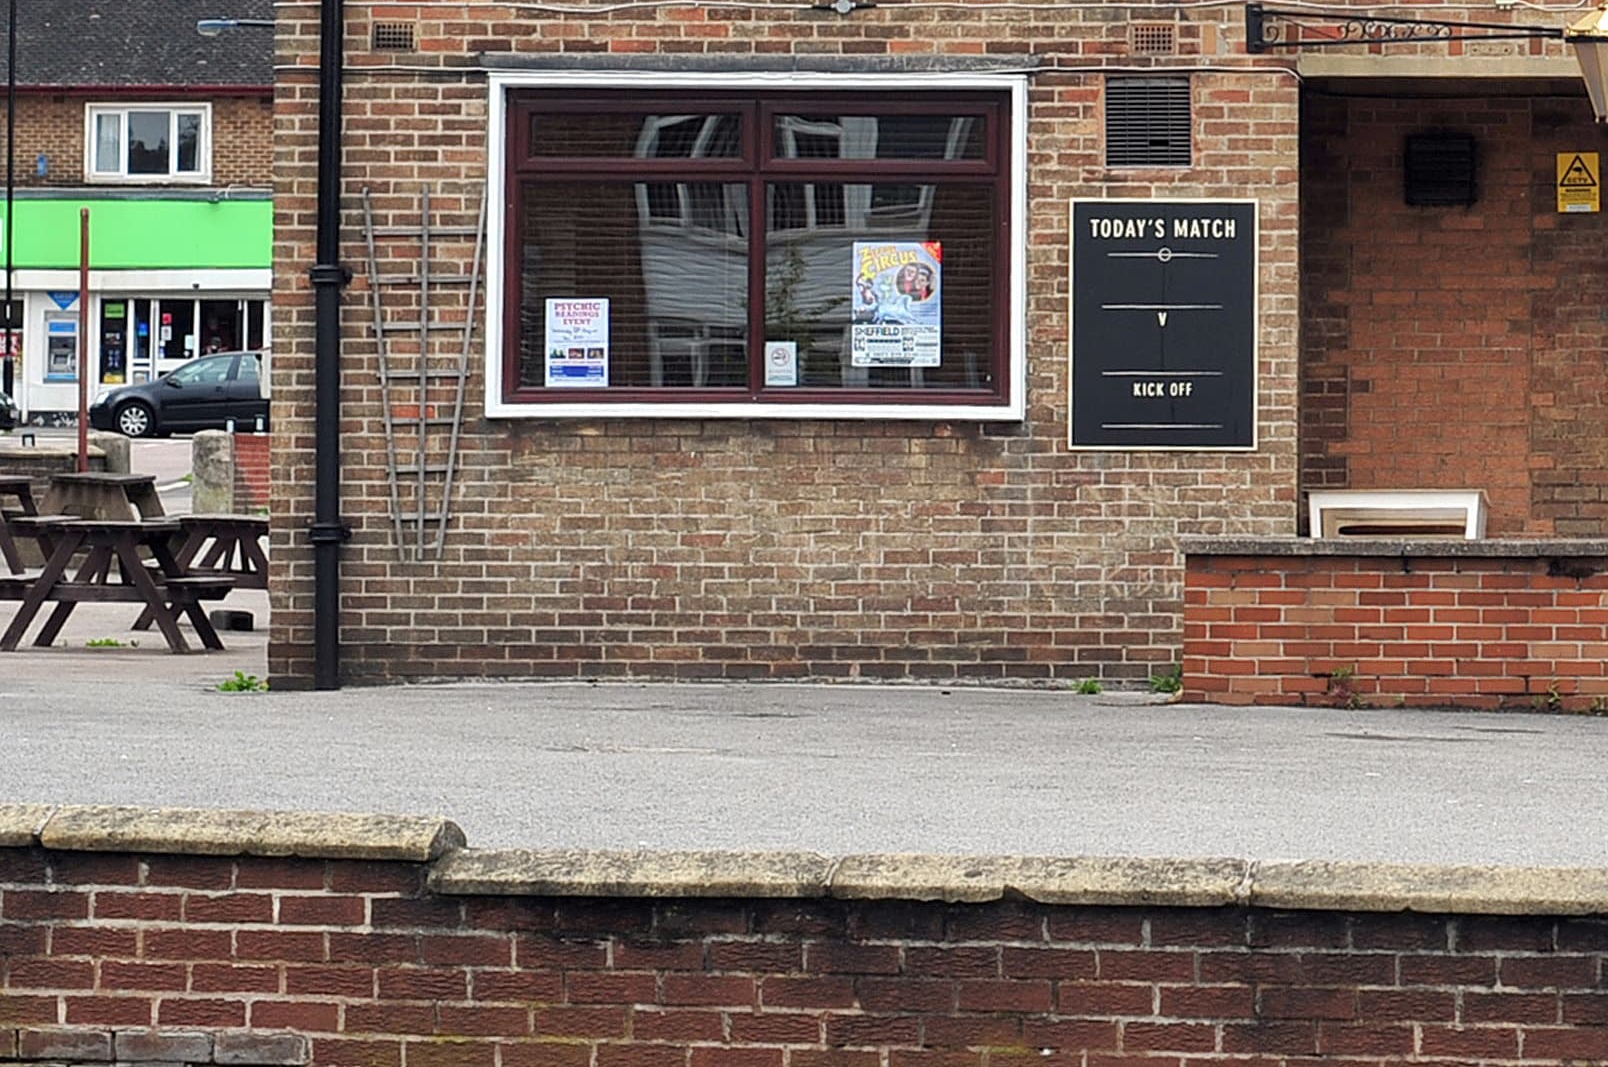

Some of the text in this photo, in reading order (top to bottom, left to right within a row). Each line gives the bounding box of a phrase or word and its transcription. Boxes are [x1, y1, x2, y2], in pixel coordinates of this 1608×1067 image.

[1089, 218, 1236, 238] TODAY'S MATCH
[861, 249, 917, 280] CIRCUS
[554, 302, 601, 311] PSYCHIC
[1133, 382, 1193, 397] KICK OFF
